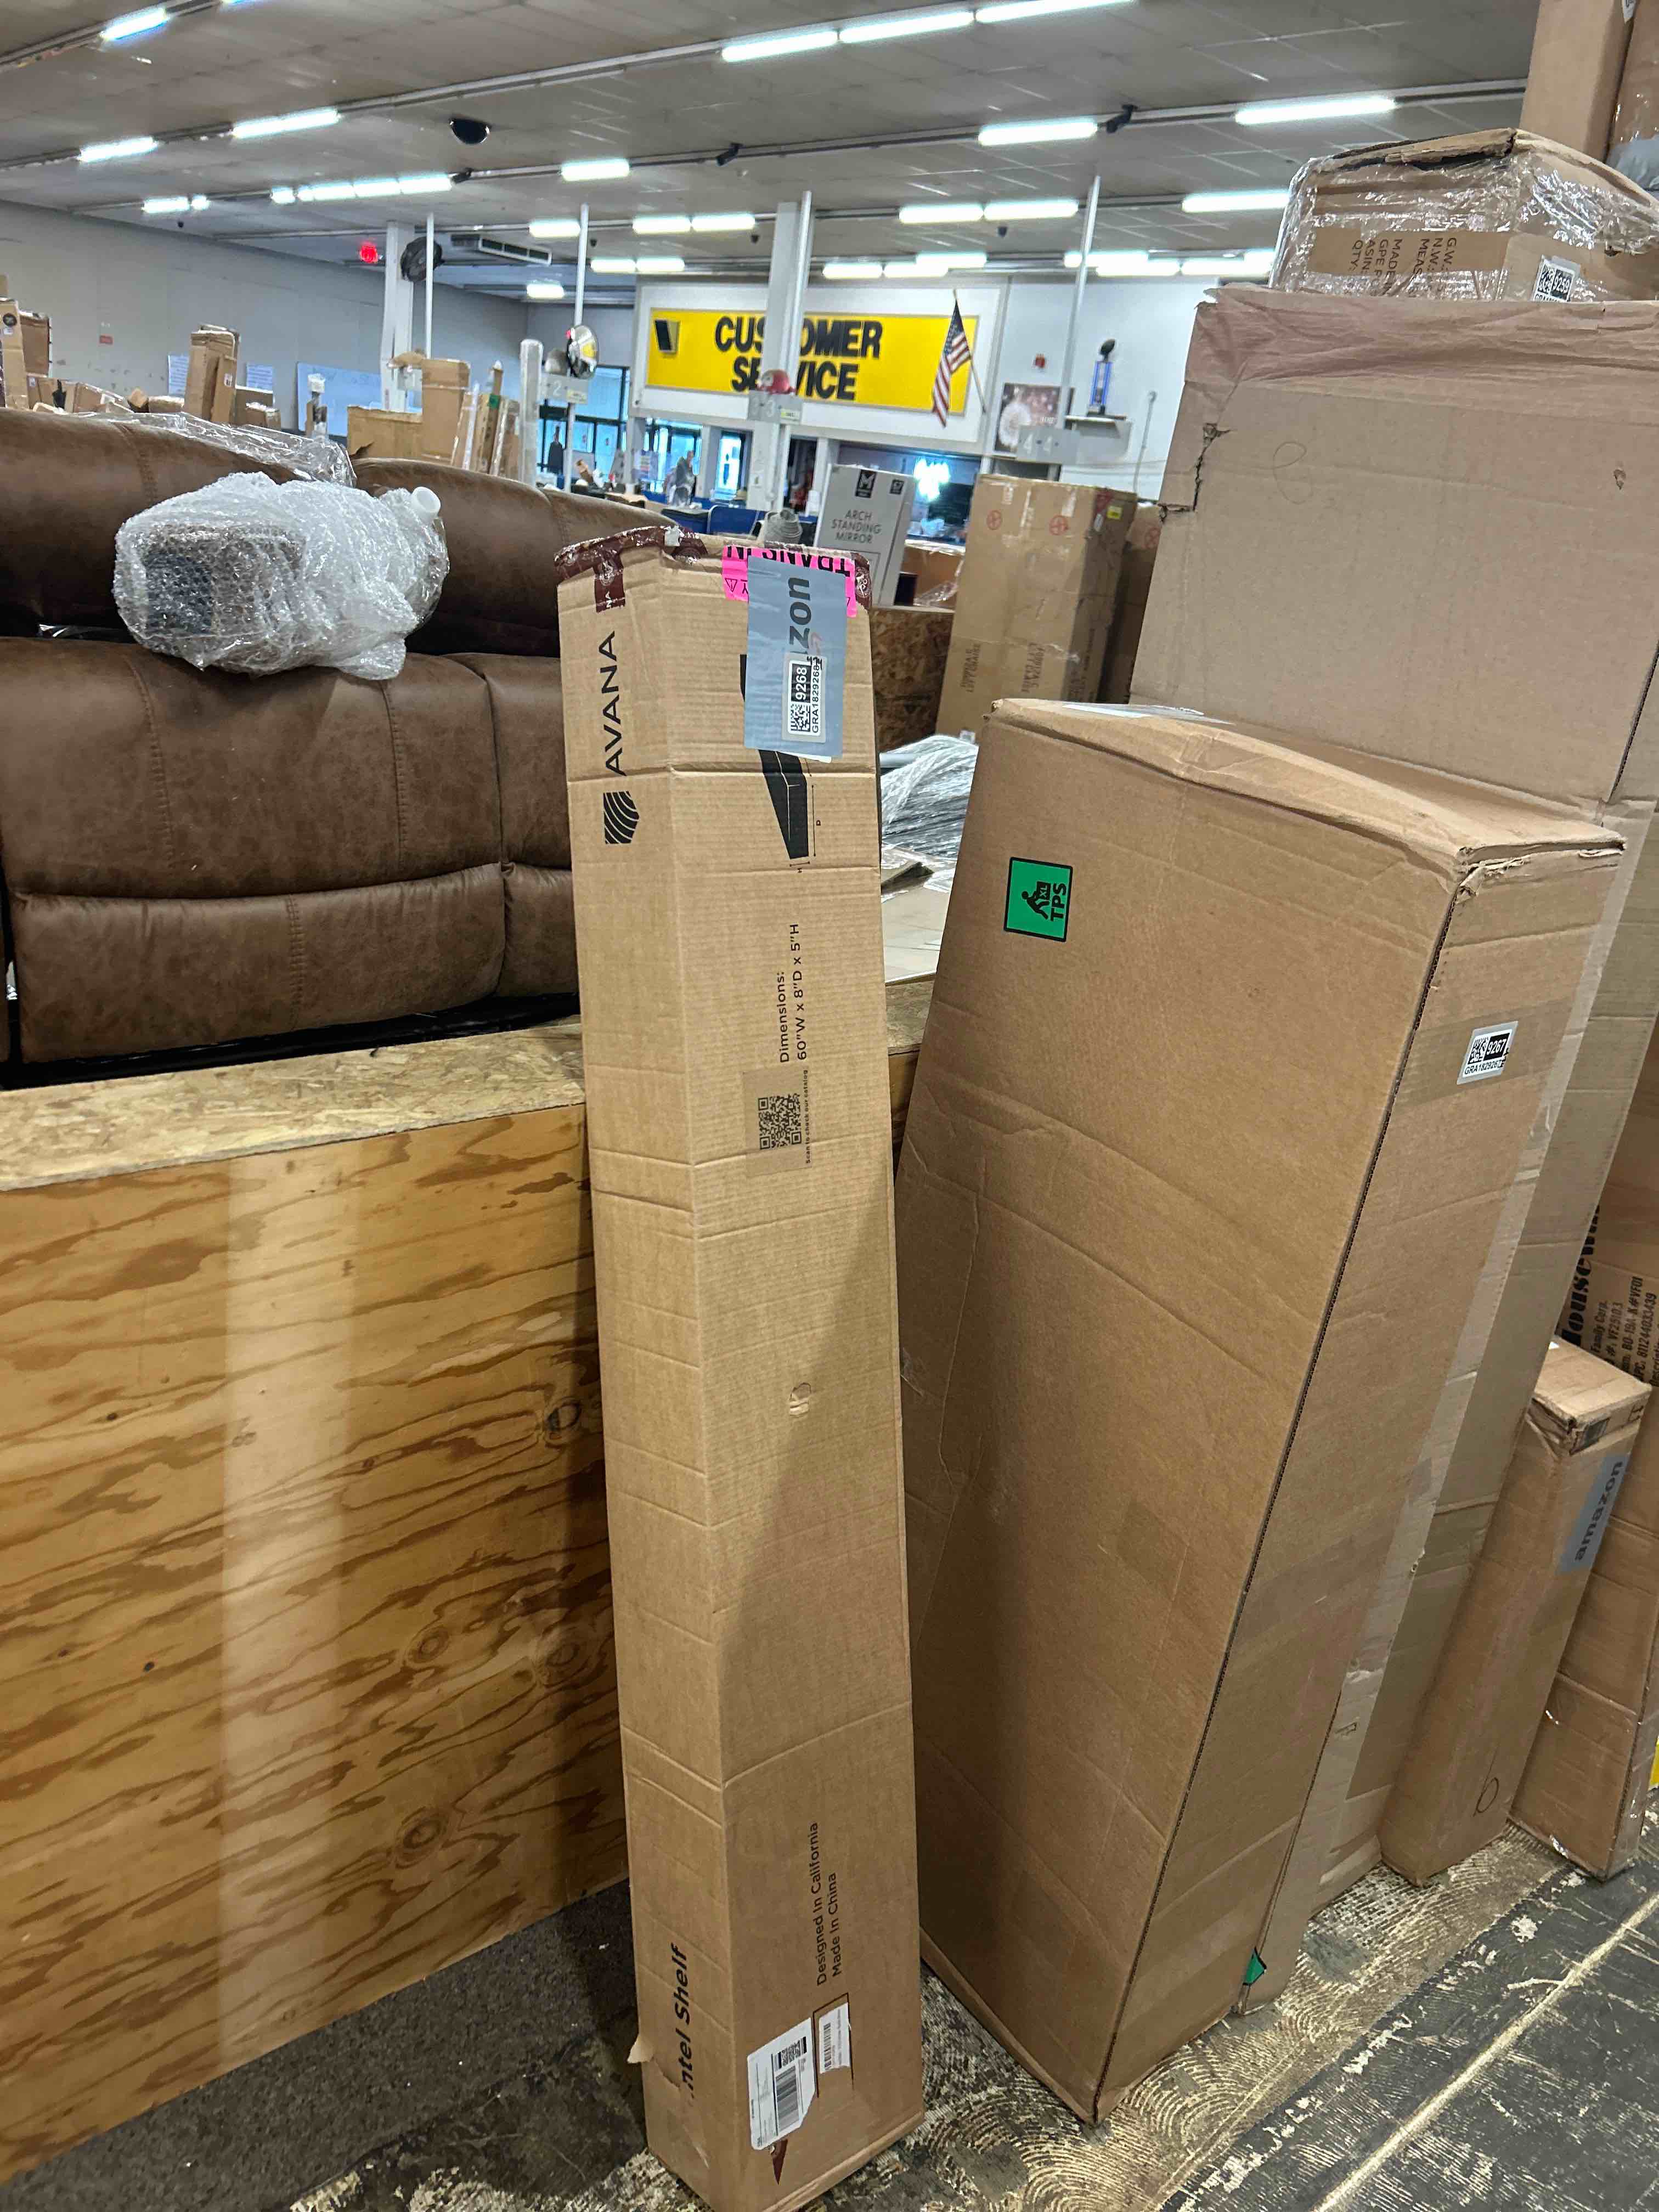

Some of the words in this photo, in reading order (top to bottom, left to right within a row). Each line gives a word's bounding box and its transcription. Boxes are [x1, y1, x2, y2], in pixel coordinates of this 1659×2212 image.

[1553, 275, 1570, 294] 9259
[715, 316, 883, 359] CUSOMER
[732, 356, 860, 400] SEVICE
[832, 519, 882, 534] STANDING
[845, 510, 872, 521] ARCH
[835, 532, 873, 544] MIRROR
[788, 577, 811, 654] zon
[599, 630, 627, 776] AVANA
[795, 667, 808, 701] 9268
[1050, 883, 1066, 922] TPS
[793, 957, 802, 965] x
[793, 970, 804, 998] 8"D
[777, 971, 789, 1063] Dimensions:
[797, 1003, 804, 1011] x
[795, 1016, 807, 1060] 60"W
[1487, 1039, 1507, 1056] 9267
[1592, 1323, 1606, 1353] Family
[1574, 1460, 1623, 1562] amazon
[808, 1822, 822, 1894] California
[812, 1897, 822, 1913] In
[827, 1872, 838, 1915] China
[829, 1917, 839, 1934] In
[813, 1914, 827, 1987] Designed
[830, 1935, 842, 1977] Made
[670, 1942, 691, 2025] Shelf
[675, 2027, 695, 2099] ntel
